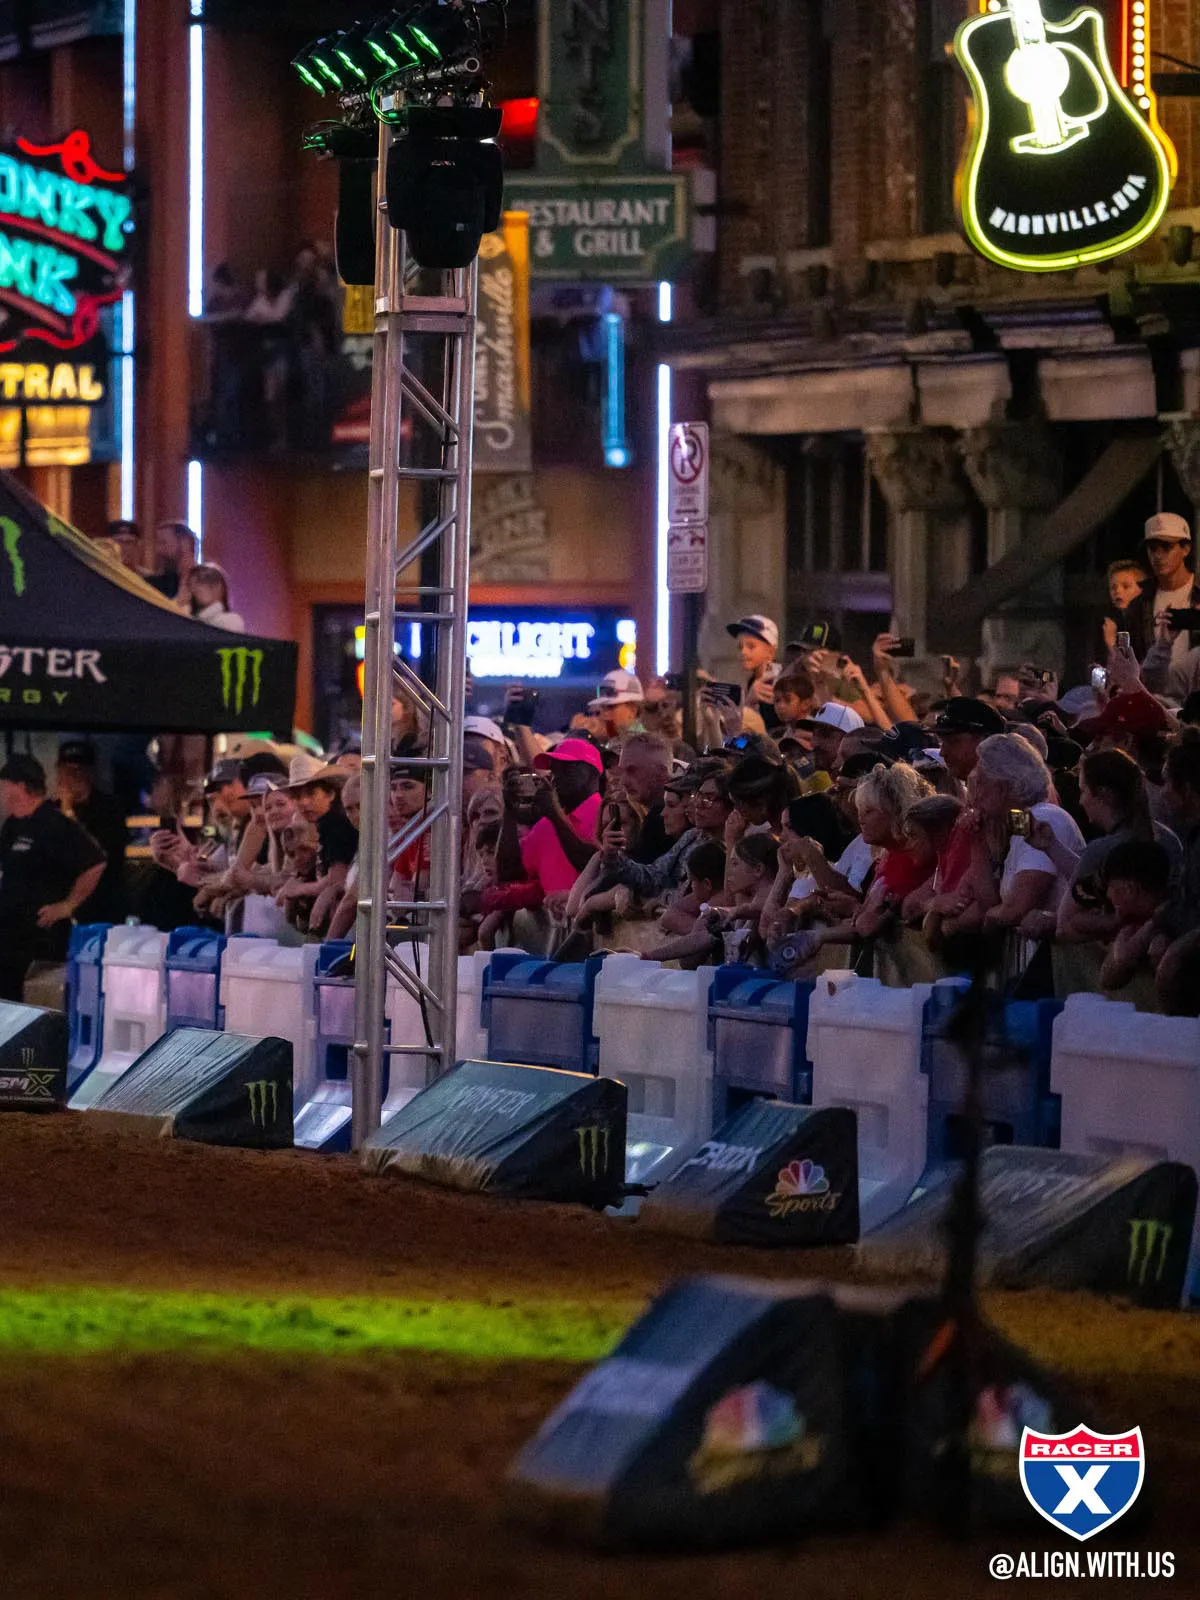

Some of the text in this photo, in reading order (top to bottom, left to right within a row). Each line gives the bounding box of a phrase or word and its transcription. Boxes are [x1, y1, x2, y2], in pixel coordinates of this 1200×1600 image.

[535, 231, 644, 256] & GRILL
[763, 1190, 842, 1219] Sports
